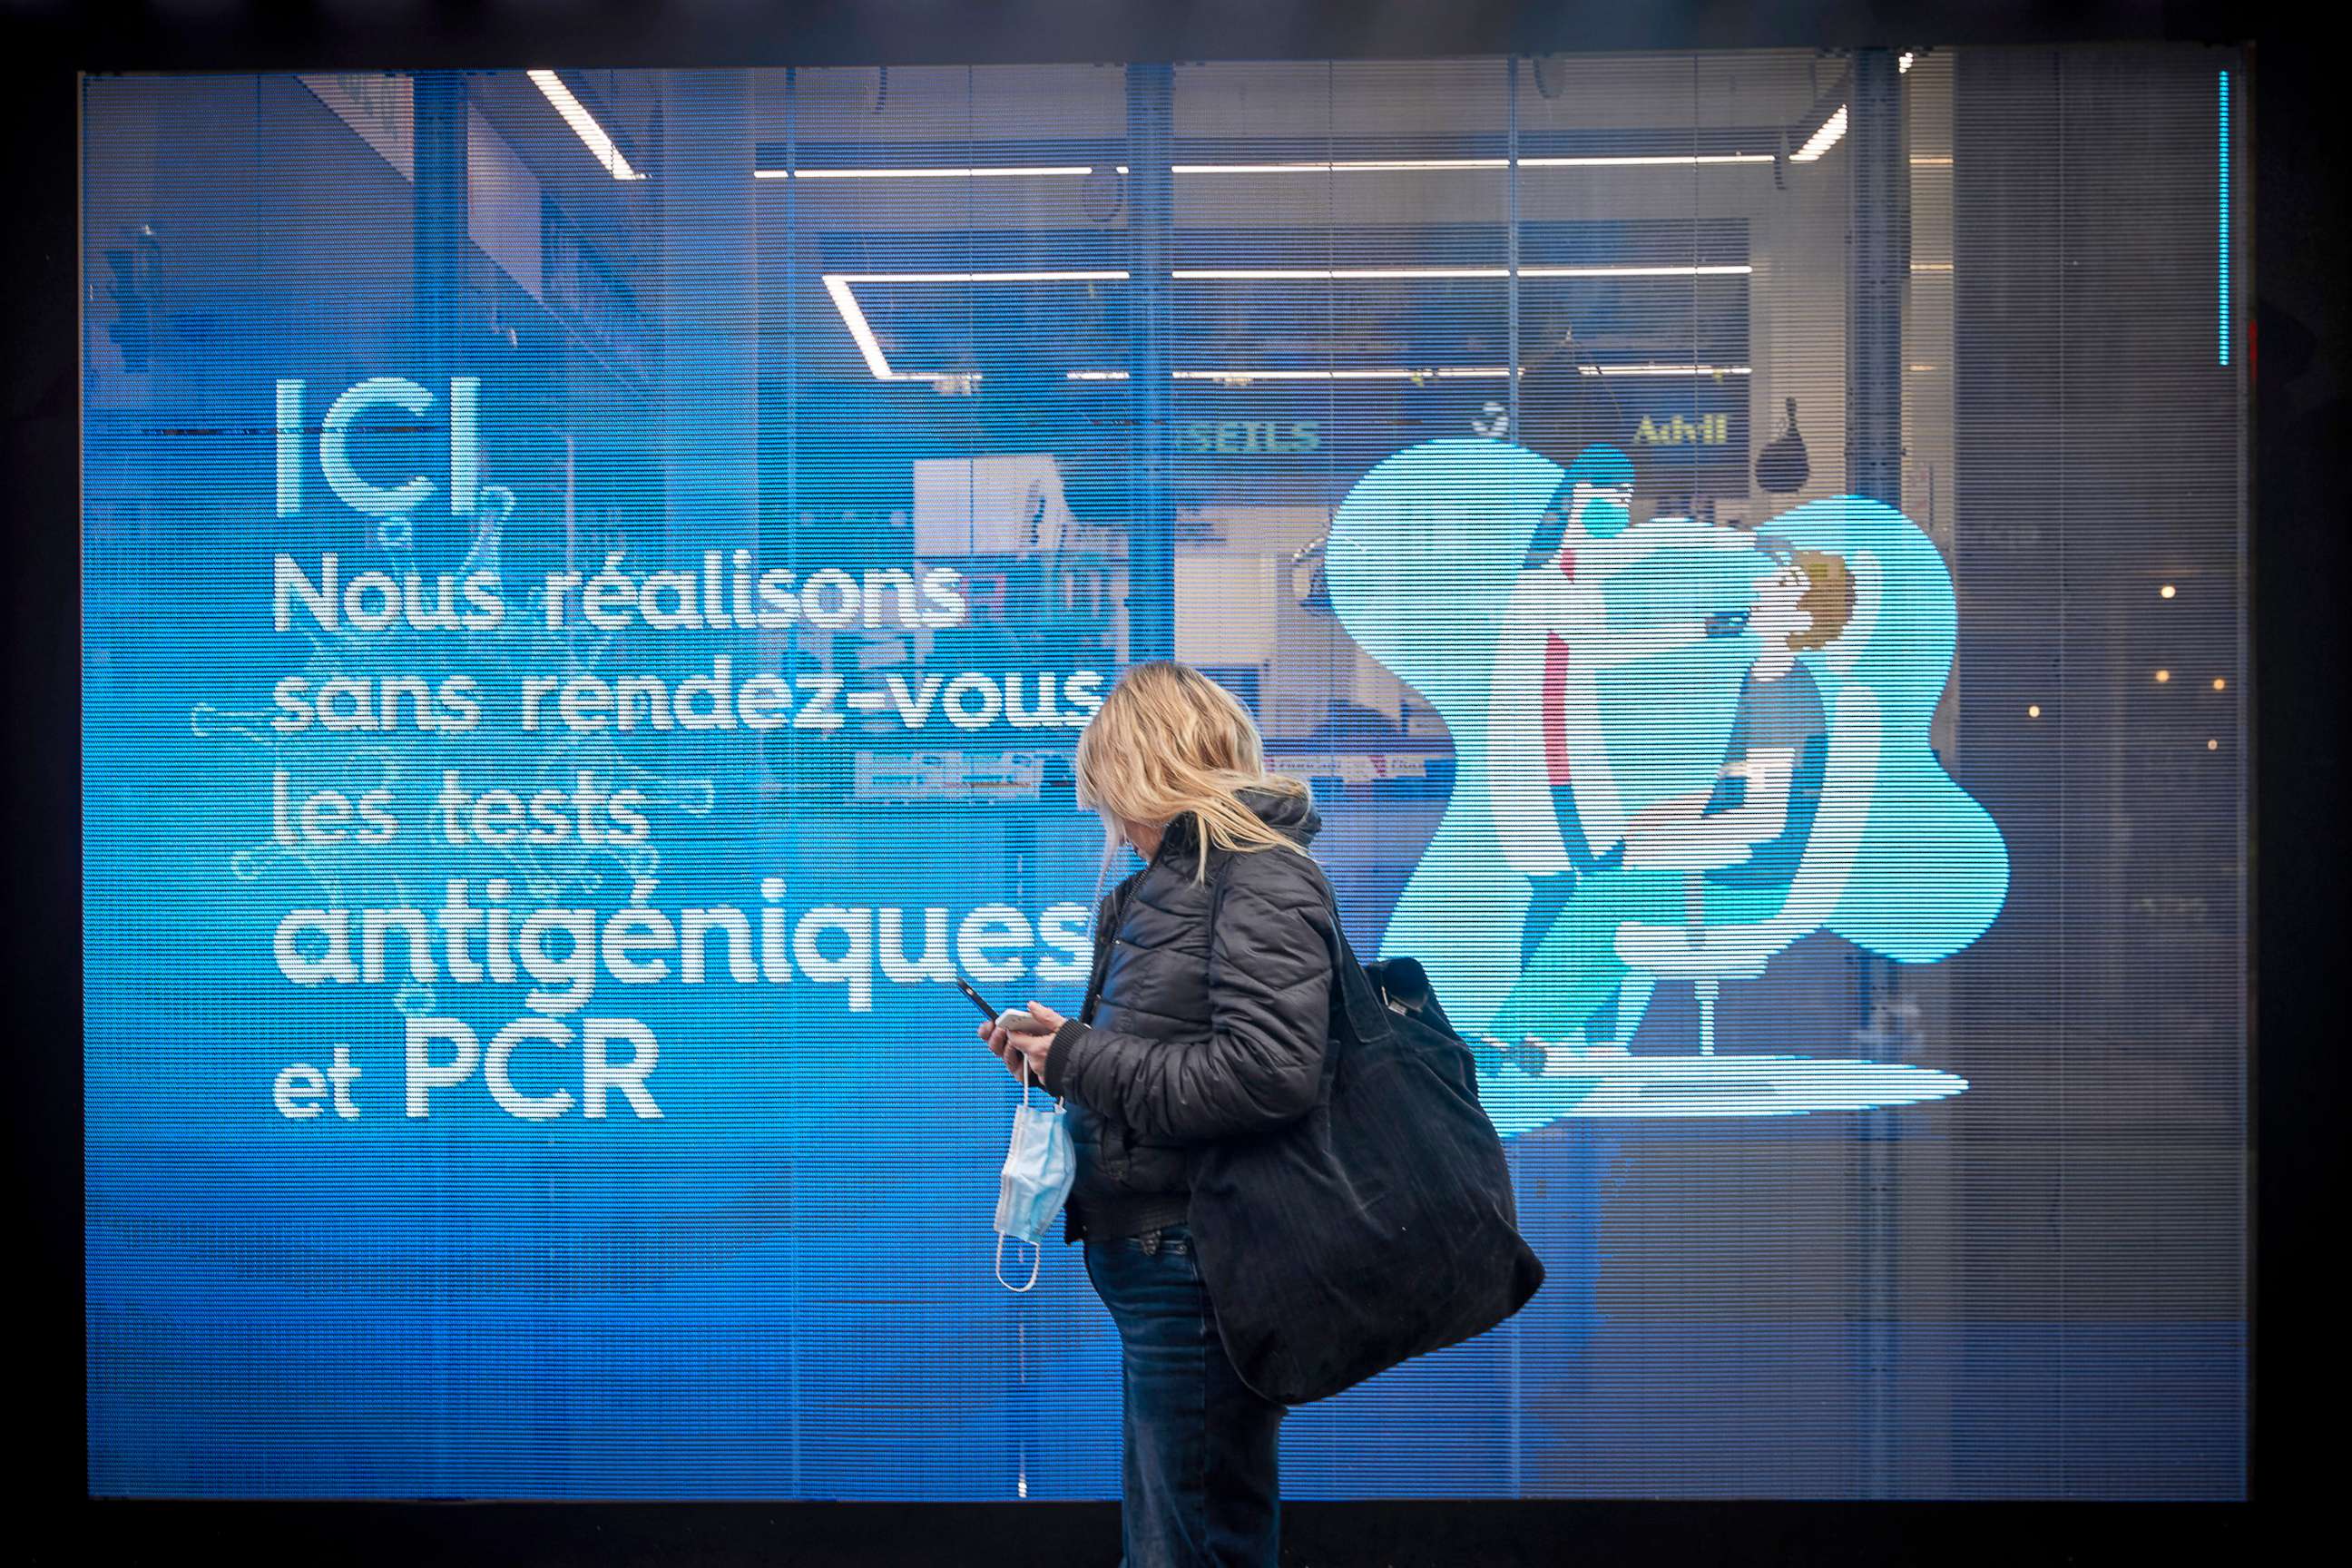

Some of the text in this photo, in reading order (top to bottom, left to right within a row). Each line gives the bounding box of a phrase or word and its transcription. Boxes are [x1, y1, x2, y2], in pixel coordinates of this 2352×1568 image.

[274, 377, 481, 519] ICI
[1632, 414, 1729, 446] Advil
[274, 550, 966, 632] Nous réalisons
[274, 653, 1104, 733] sans rendez-vous
[274, 770, 651, 846] les tests
[274, 877, 1095, 1013] antigéniques
[272, 1015, 666, 1121] et PCR
